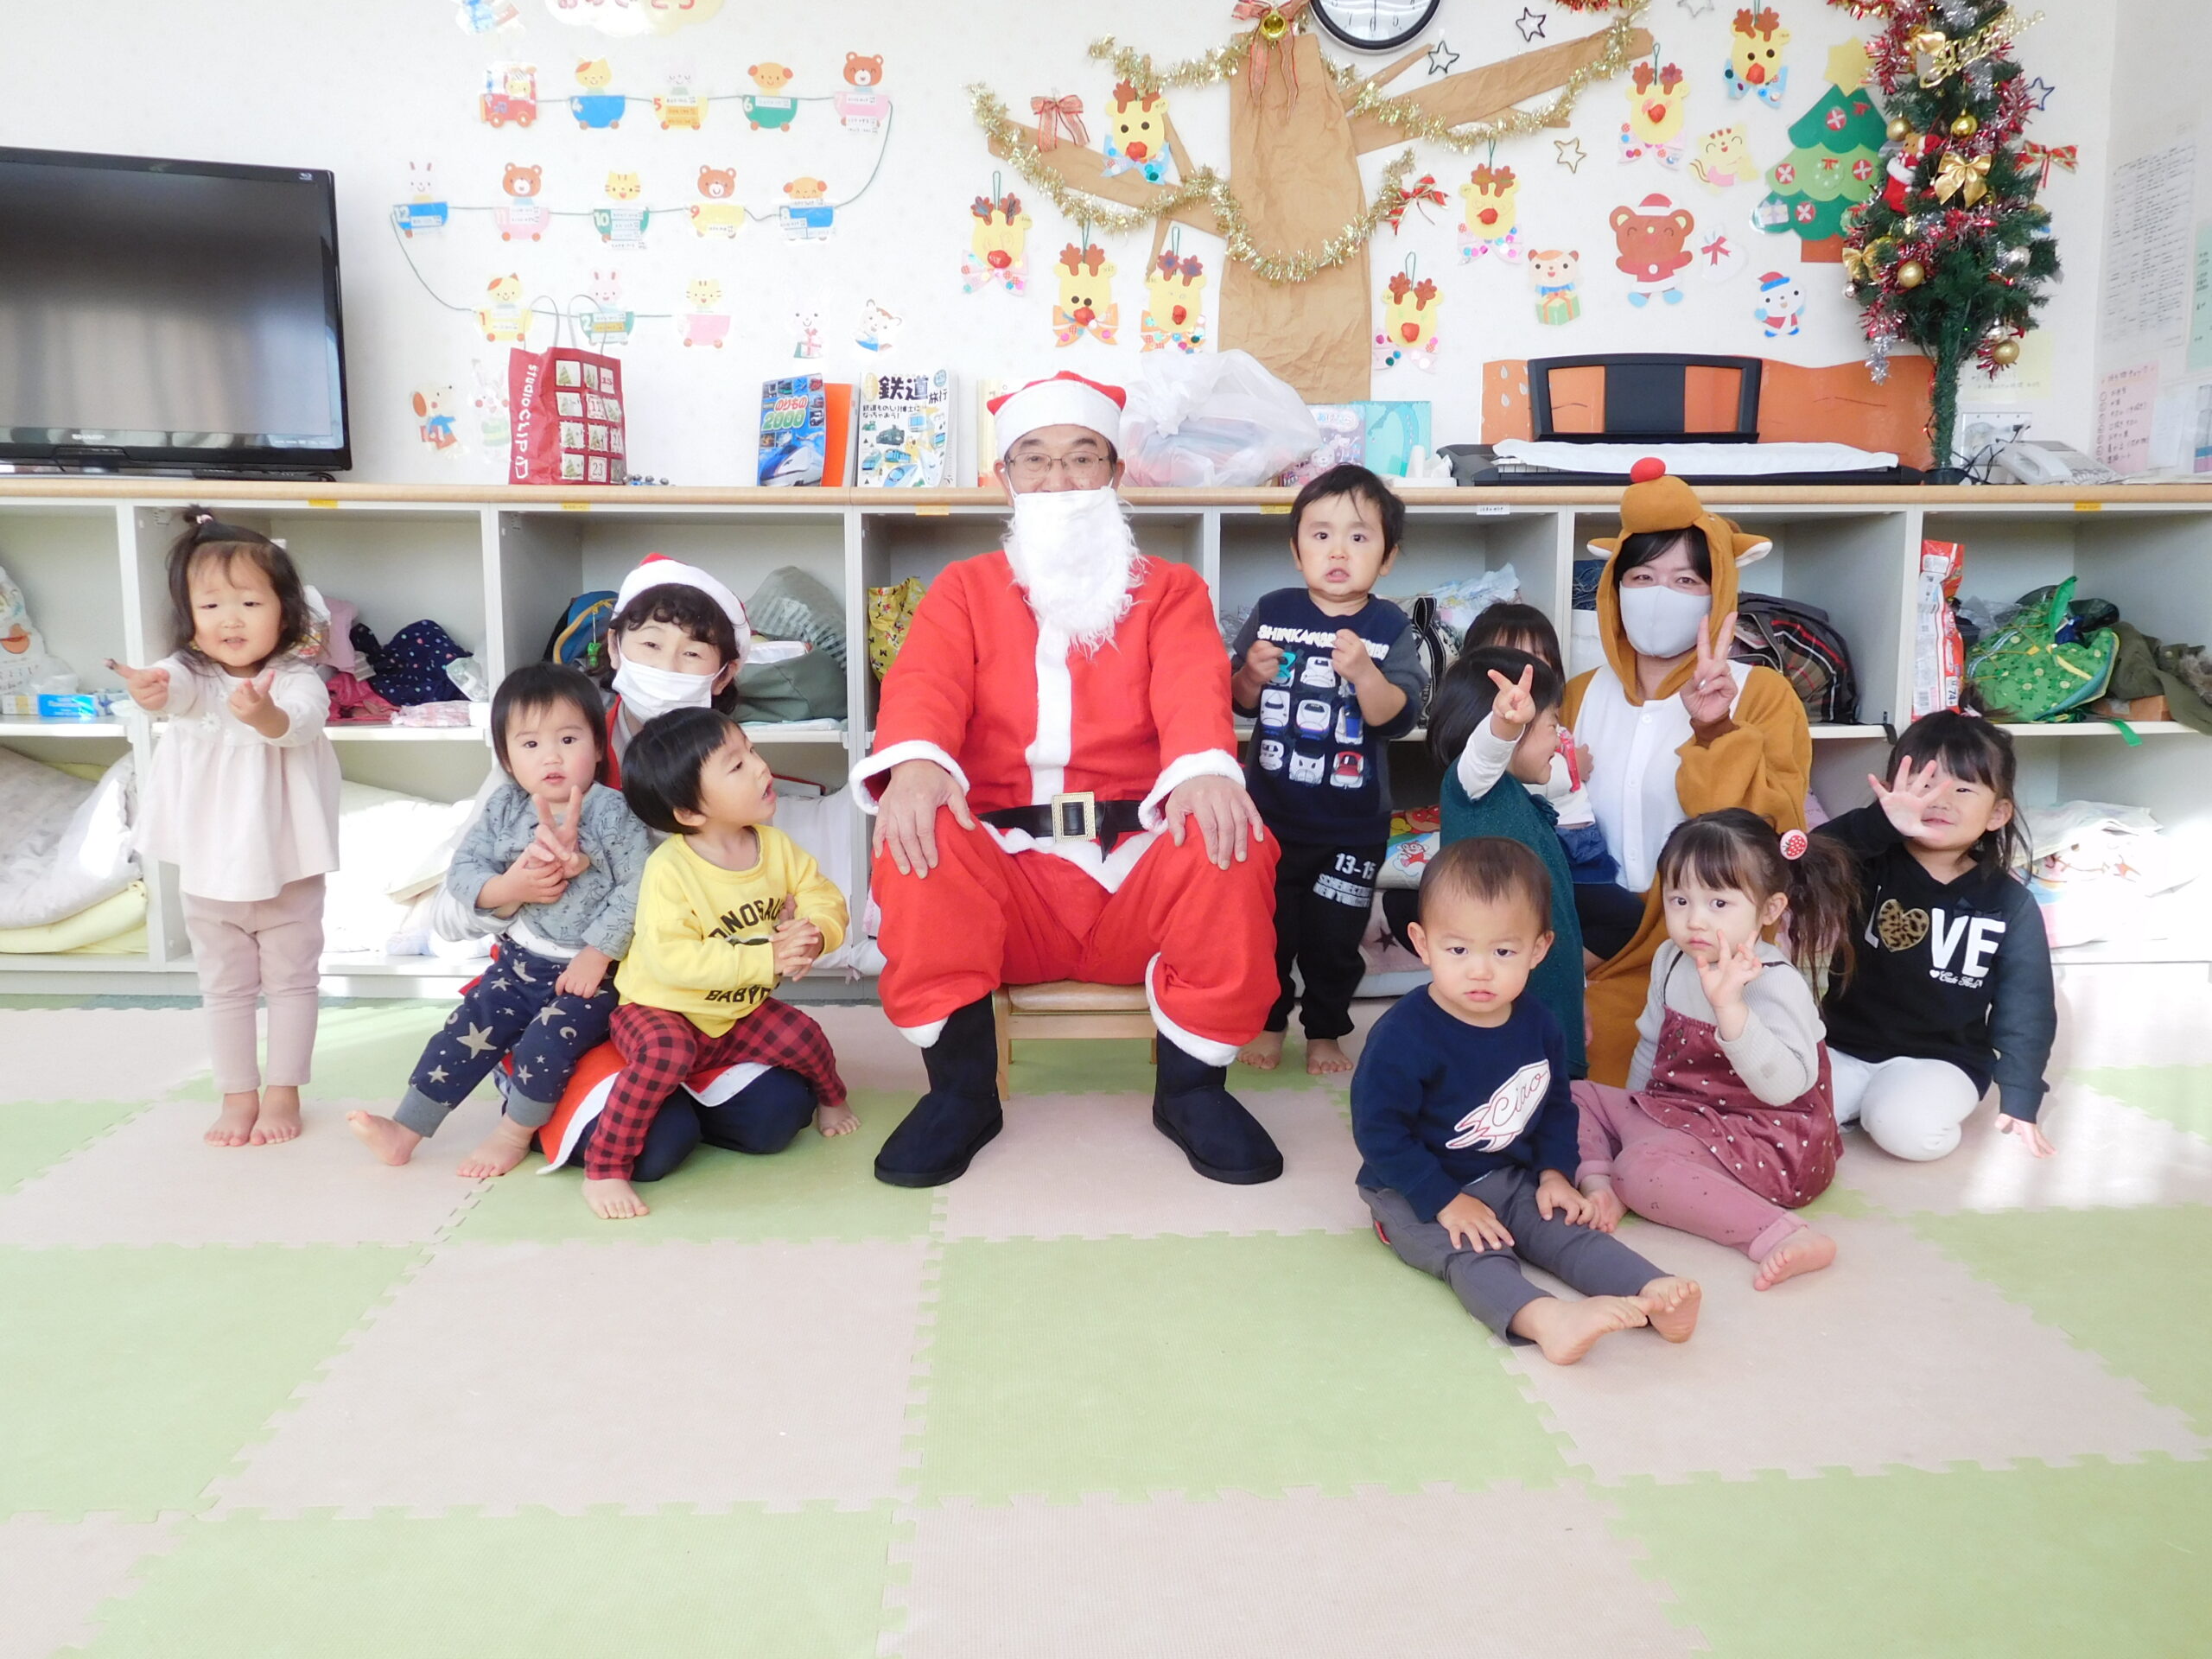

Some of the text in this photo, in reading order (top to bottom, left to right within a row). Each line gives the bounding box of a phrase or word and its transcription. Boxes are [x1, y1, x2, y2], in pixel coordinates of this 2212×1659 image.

[653, 98, 663, 111] 5
[743, 97, 754, 113] 6
[690, 205, 700, 219] 9
[592, 212, 609, 227] 10
[479, 312, 486, 326] 1
[775, 397, 809, 411] のりもの
[762, 410, 806, 430] 2000
[592, 461, 603, 476] 23
